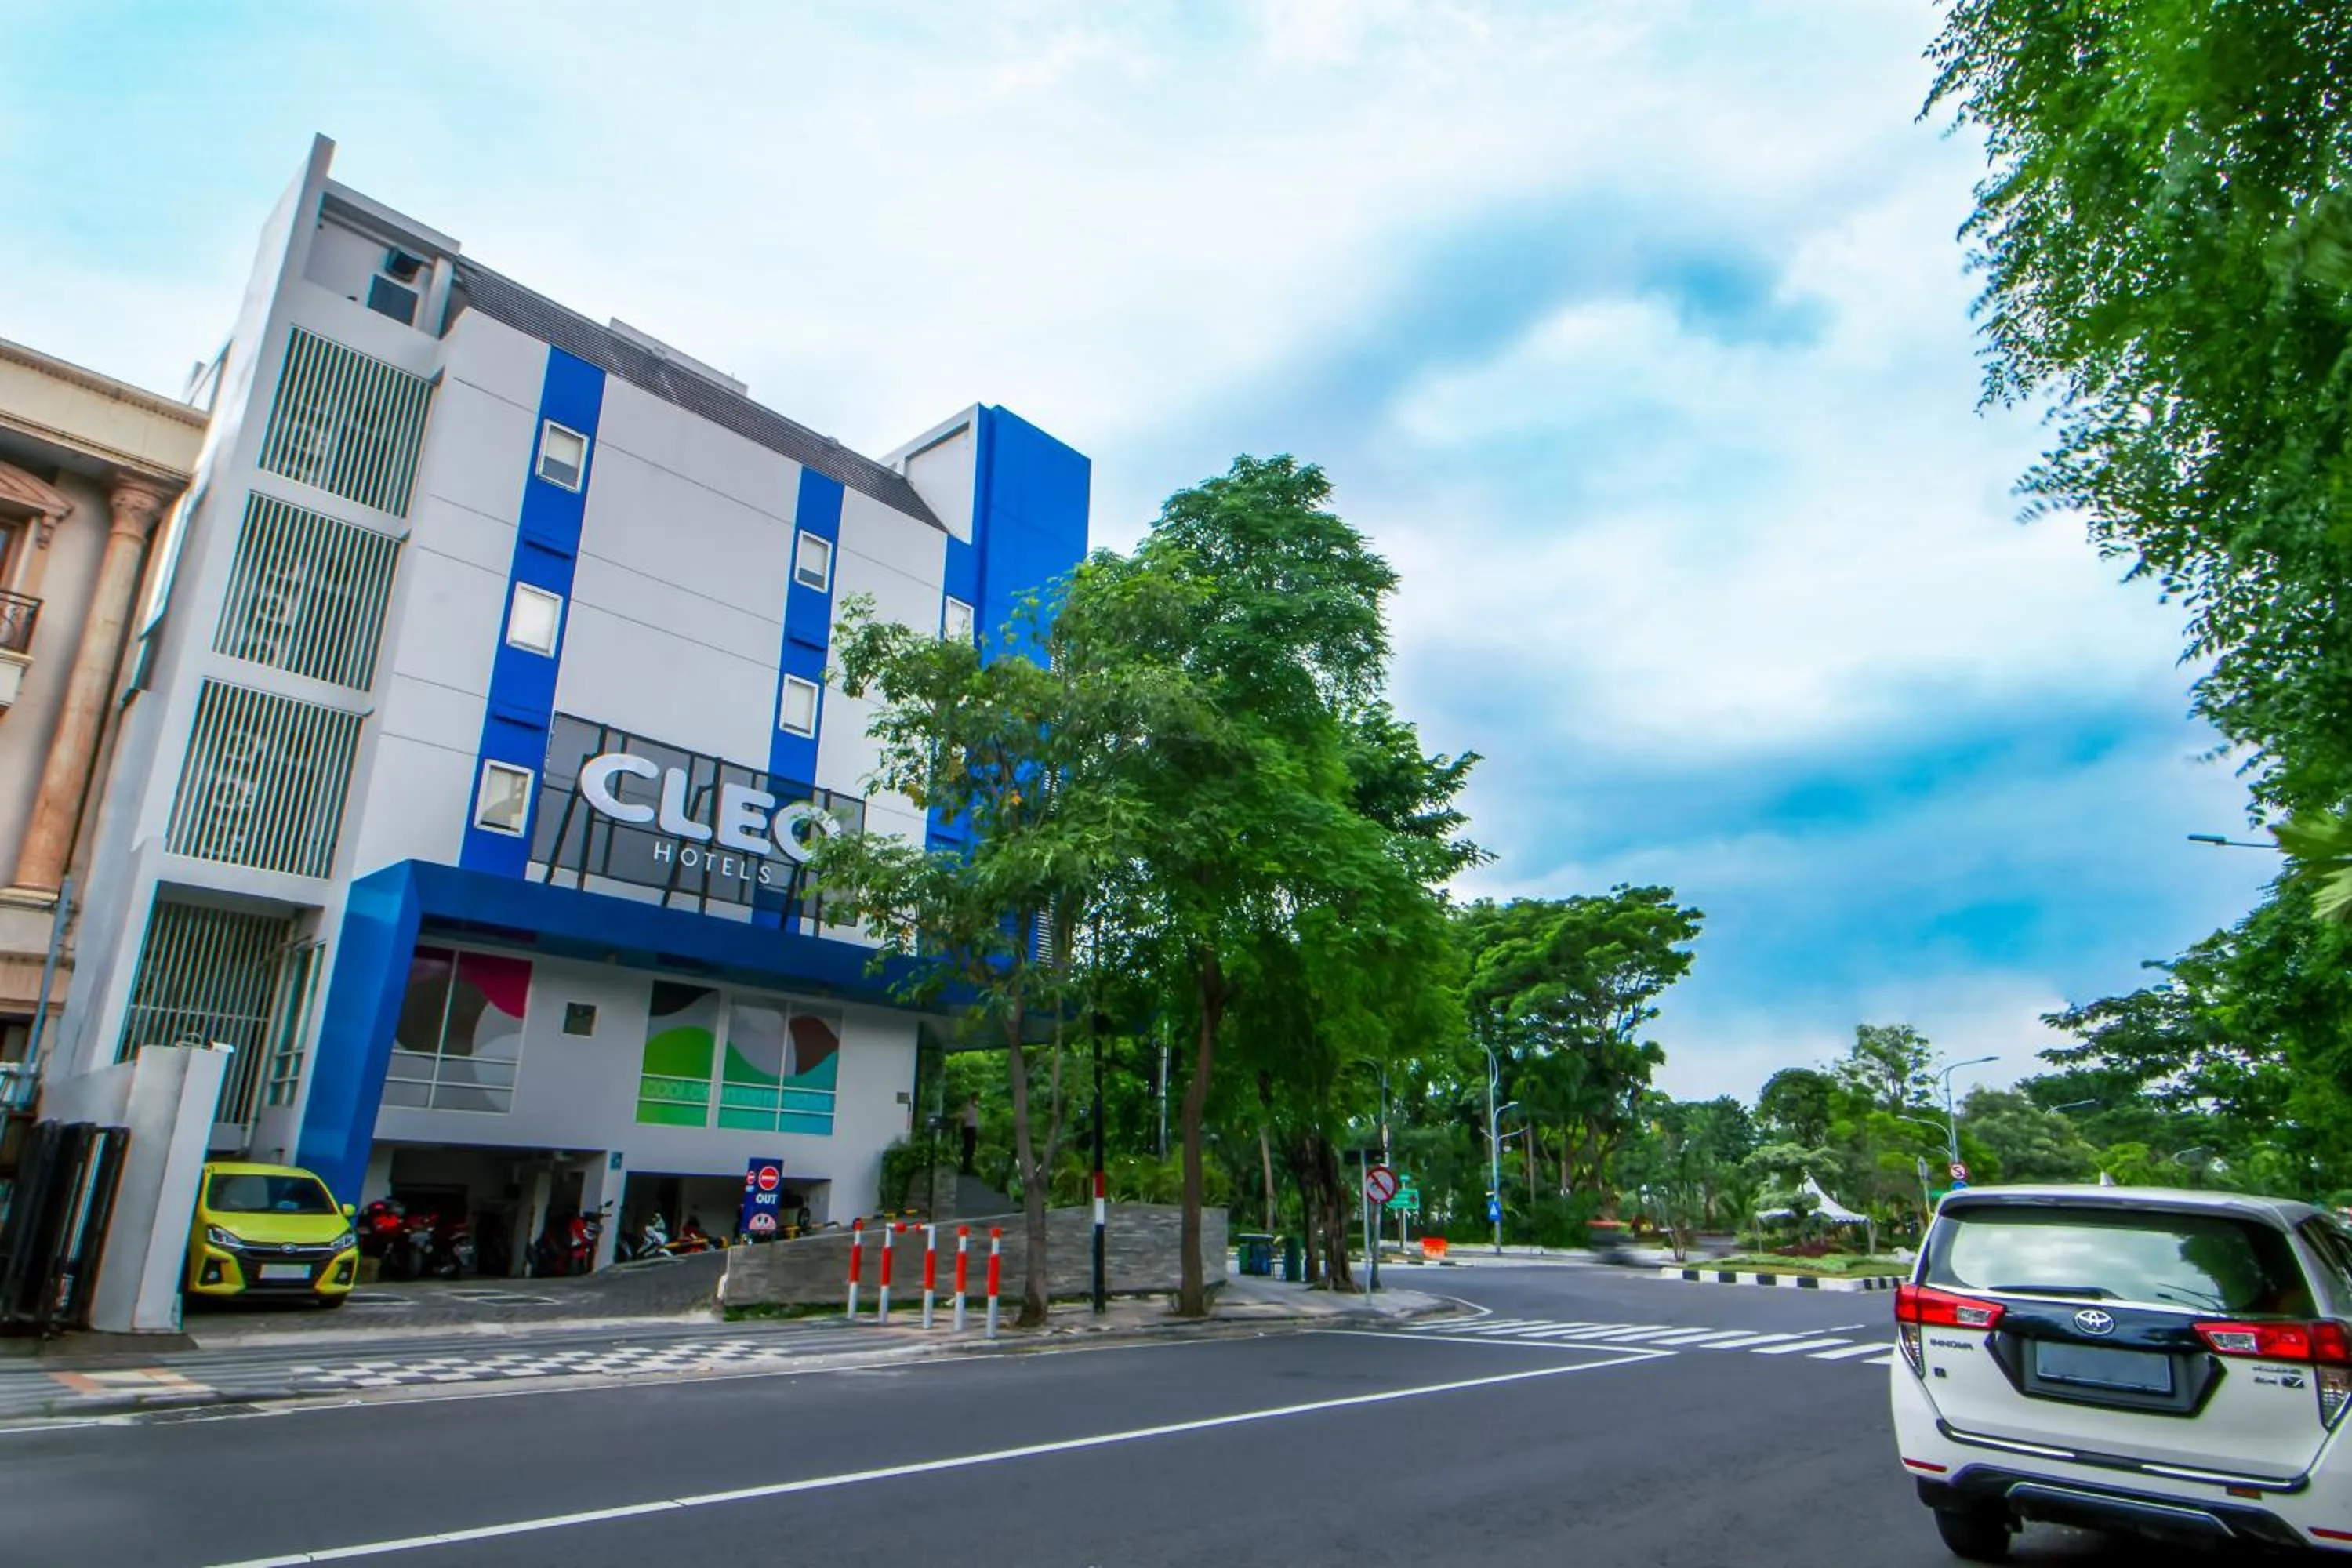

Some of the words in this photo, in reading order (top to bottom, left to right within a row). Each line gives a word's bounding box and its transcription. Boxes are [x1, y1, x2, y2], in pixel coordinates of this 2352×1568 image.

[581, 753, 841, 863] CLEO
[653, 841, 771, 884] HOTELS
[755, 1193, 778, 1205] OUT
